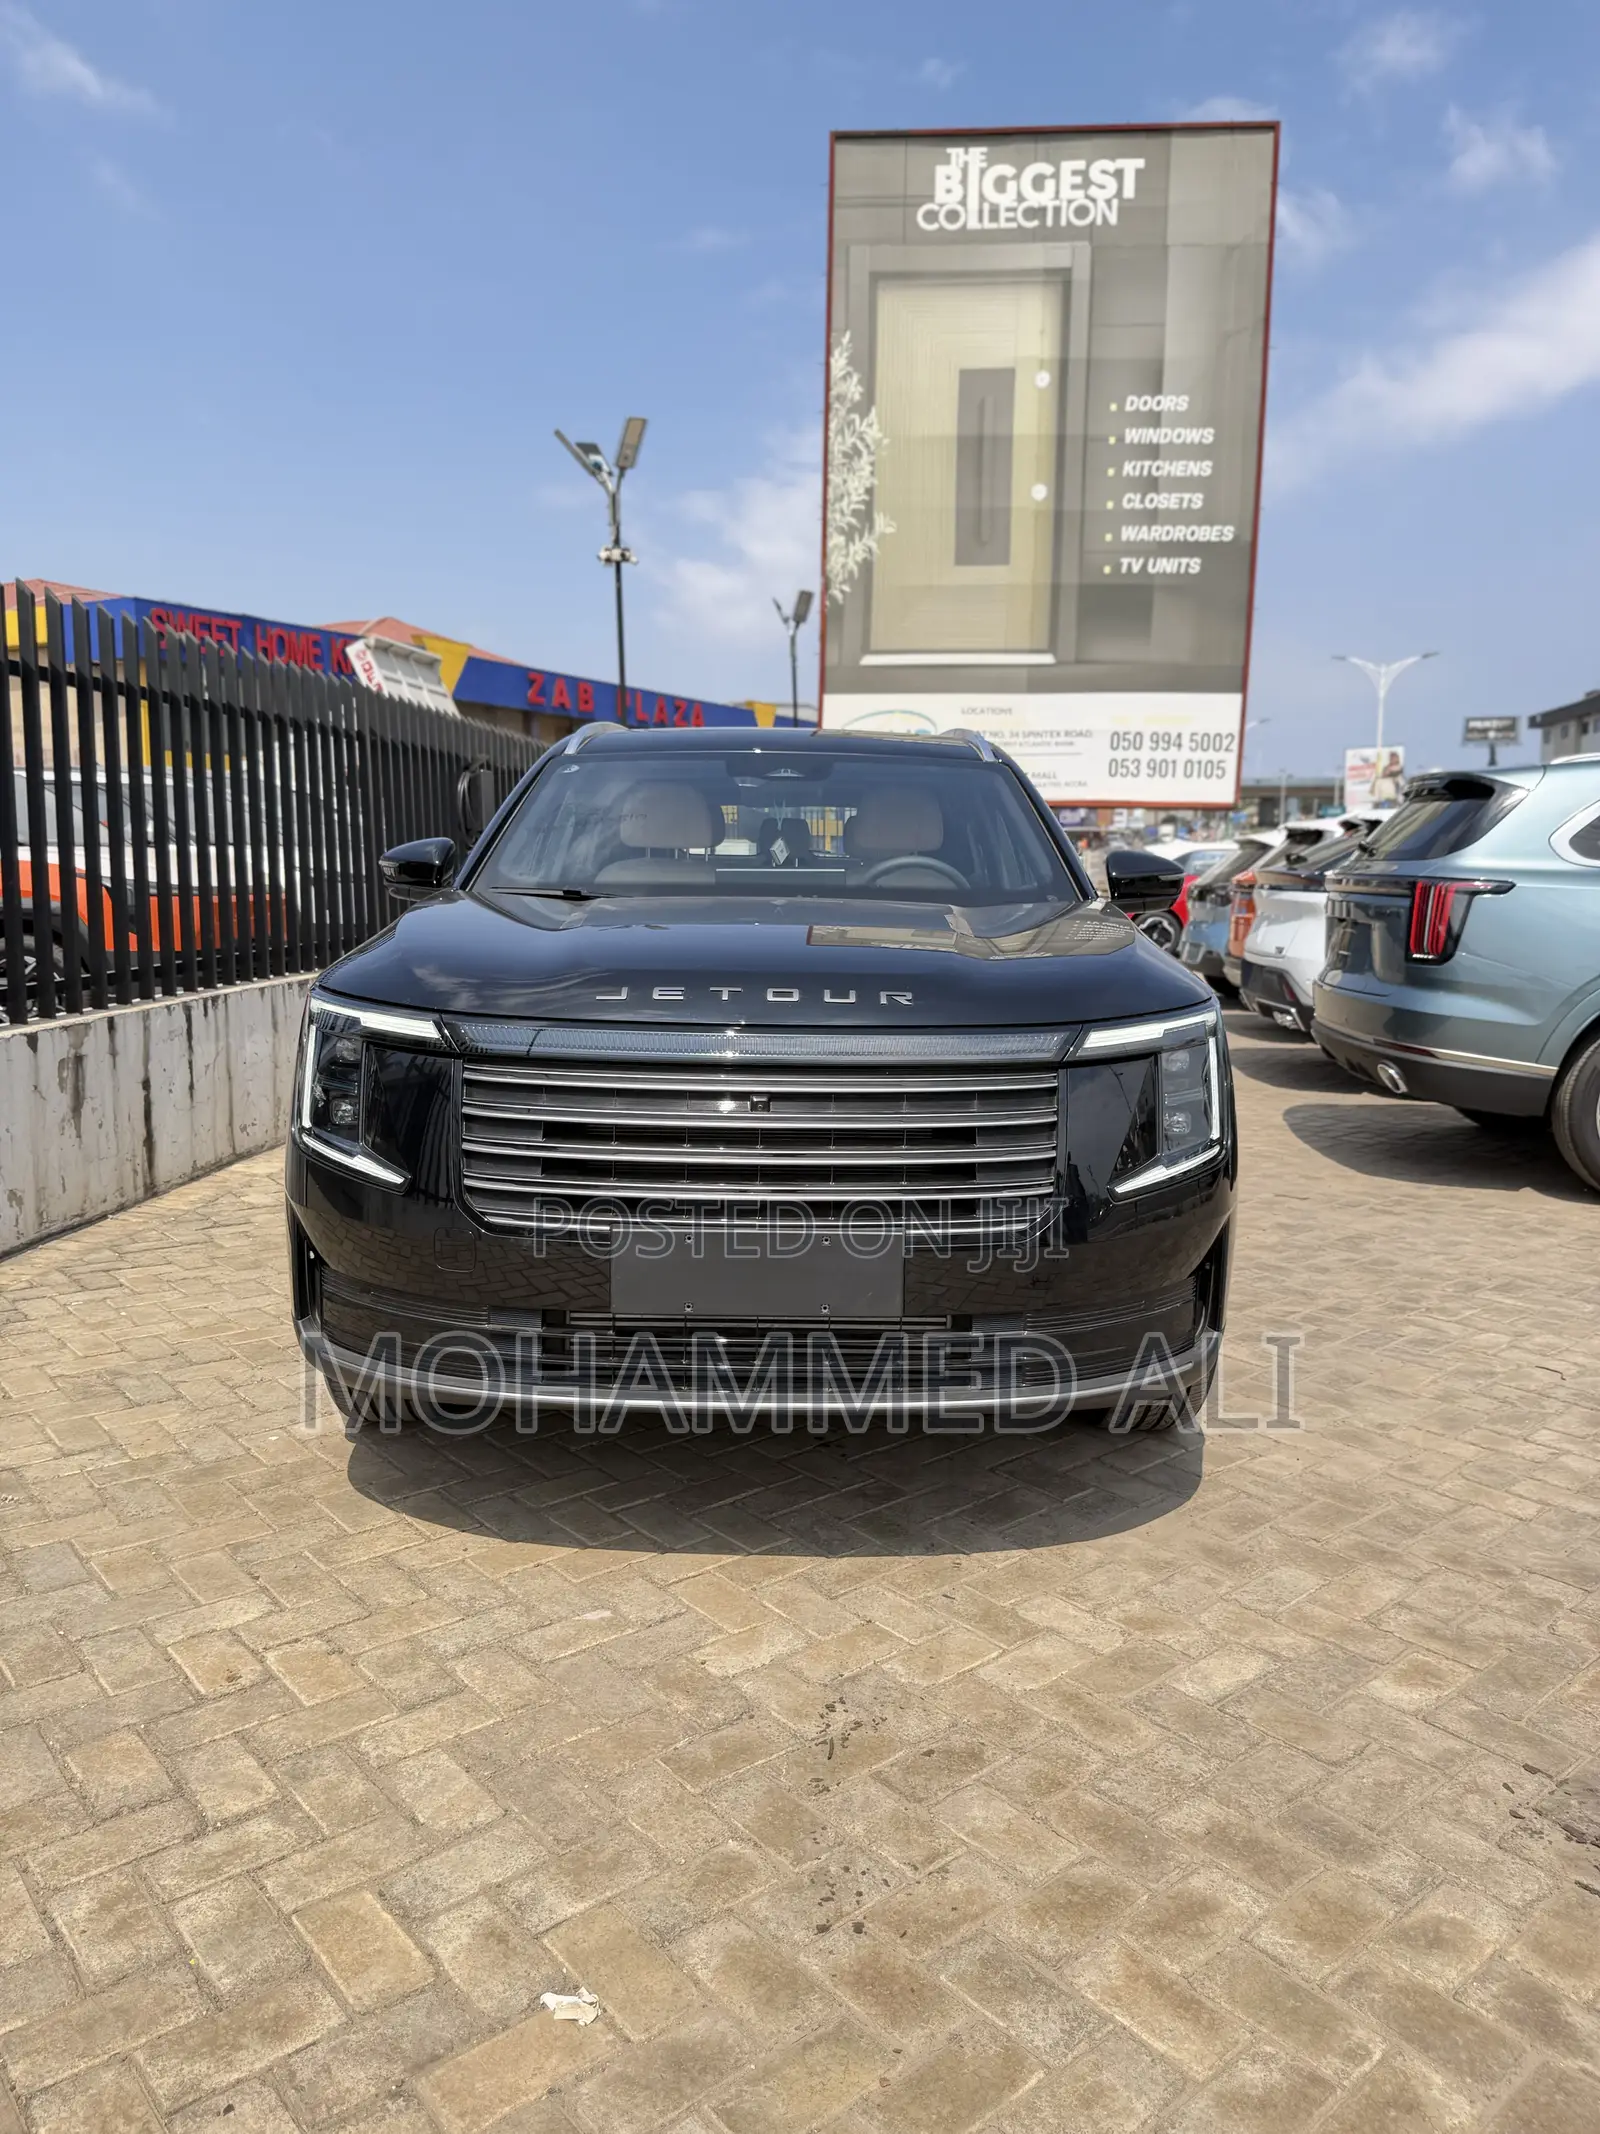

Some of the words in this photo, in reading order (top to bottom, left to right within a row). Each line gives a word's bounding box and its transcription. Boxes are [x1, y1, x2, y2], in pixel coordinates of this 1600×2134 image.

[946, 147, 988, 168] THE
[934, 158, 1146, 206] BIGGEST
[916, 198, 1118, 230] COLLECTION
[1124, 395, 1189, 411] DOORS
[1124, 428, 1215, 444] WINDOWS
[1122, 460, 1213, 477] KITCHENS
[1121, 493, 1204, 509] CLOSETS
[1120, 525, 1235, 542] WARDROBES
[1120, 557, 1144, 574] TV
[1147, 557, 1202, 574] UNITS
[255, 624, 323, 671] HOME
[527, 672, 595, 713] ZAB
[1110, 731, 1143, 751] 050
[1149, 731, 1183, 752] 994
[1189, 732, 1235, 752] 5002
[1108, 758, 1141, 778] 053
[1146, 758, 1177, 778] 901
[1184, 759, 1226, 779] 0105
[596, 986, 912, 1005] JETOUR
